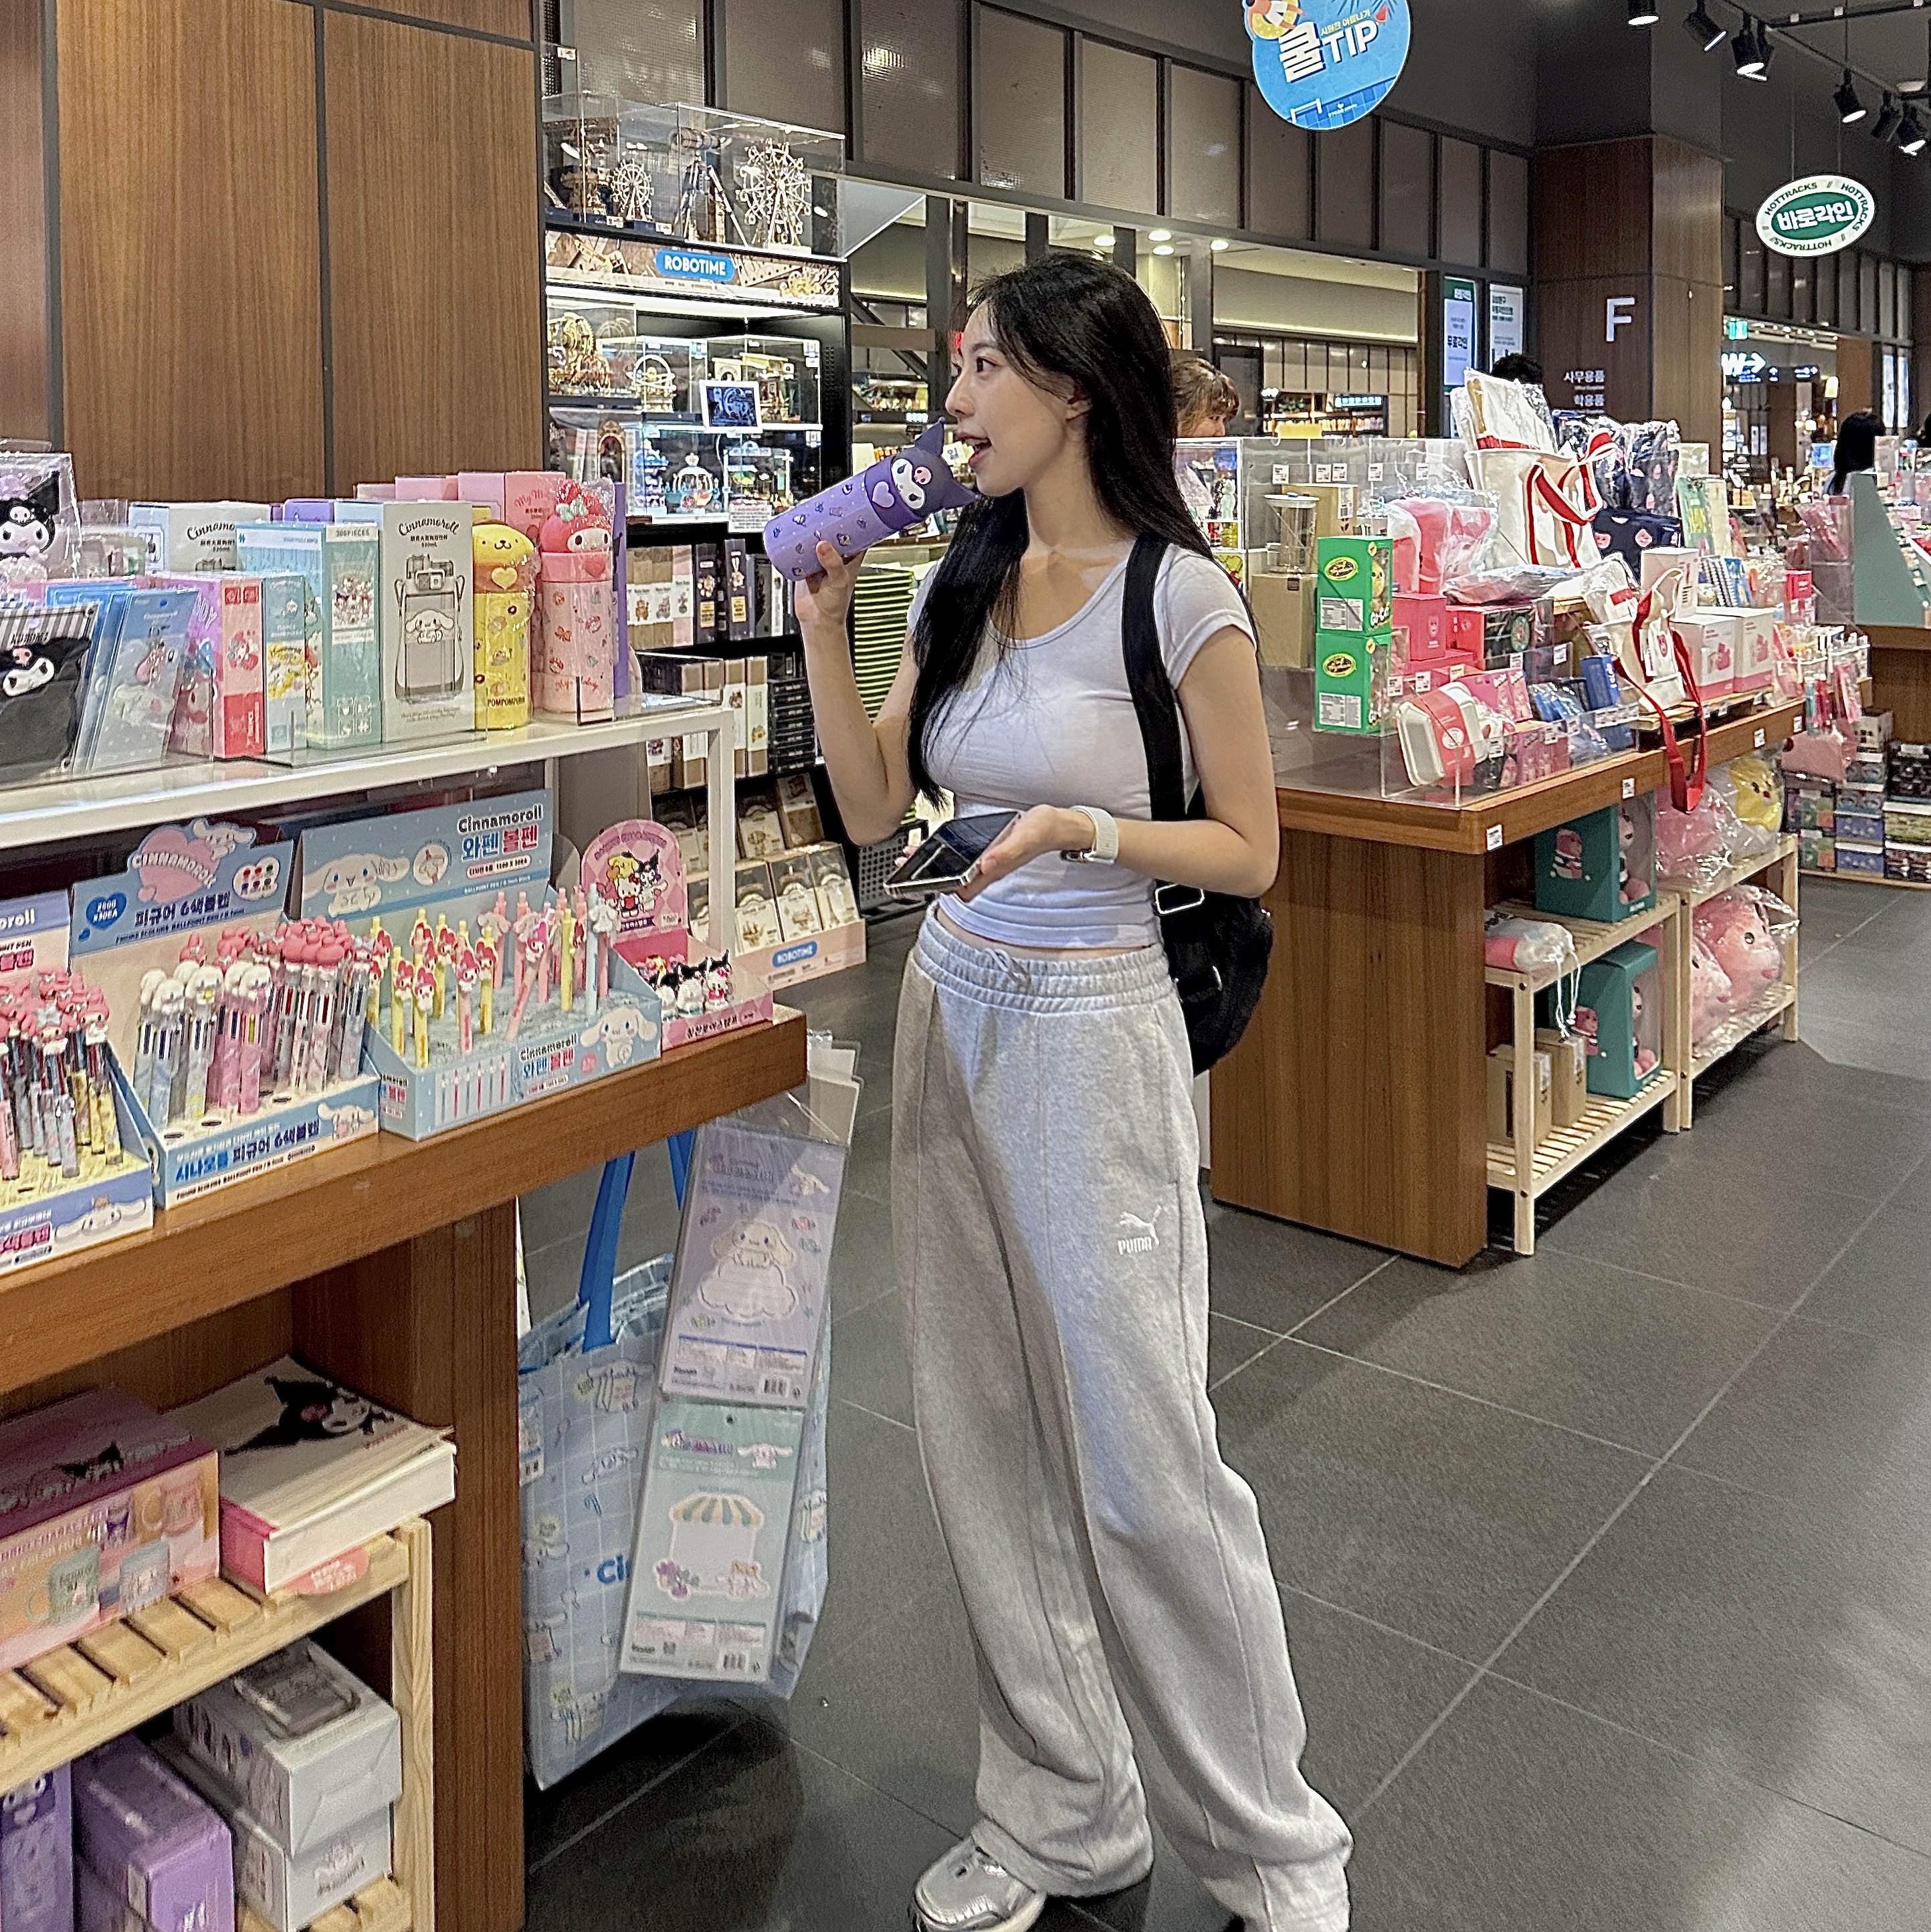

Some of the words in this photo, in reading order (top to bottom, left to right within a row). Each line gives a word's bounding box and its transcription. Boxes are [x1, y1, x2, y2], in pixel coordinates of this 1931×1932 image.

[1279, 21, 1324, 82] 쿨
[1322, 20, 1379, 63] TIP
[1764, 182, 1818, 216] HOTTRACKS
[1841, 183, 1868, 231] HOTTRACKS
[1774, 237, 1832, 251] HOTTRACKS
[664, 254, 726, 276] ROBOTIME
[1607, 296, 1635, 342] F
[1563, 370, 1604, 383] 사무용품
[1574, 394, 1604, 407] 학용품
[398, 518, 460, 536] Cinnamoroll
[458, 804, 542, 833] Cinnamoroll
[463, 831, 499, 860] 와펜
[503, 825, 538, 853] 볼펜
[134, 903, 176, 927] 피규어
[777, 945, 813, 964] ROBOTIME
[233, 1136, 270, 1162] 피규어
[1118, 1237, 1152, 1255] PUMA
